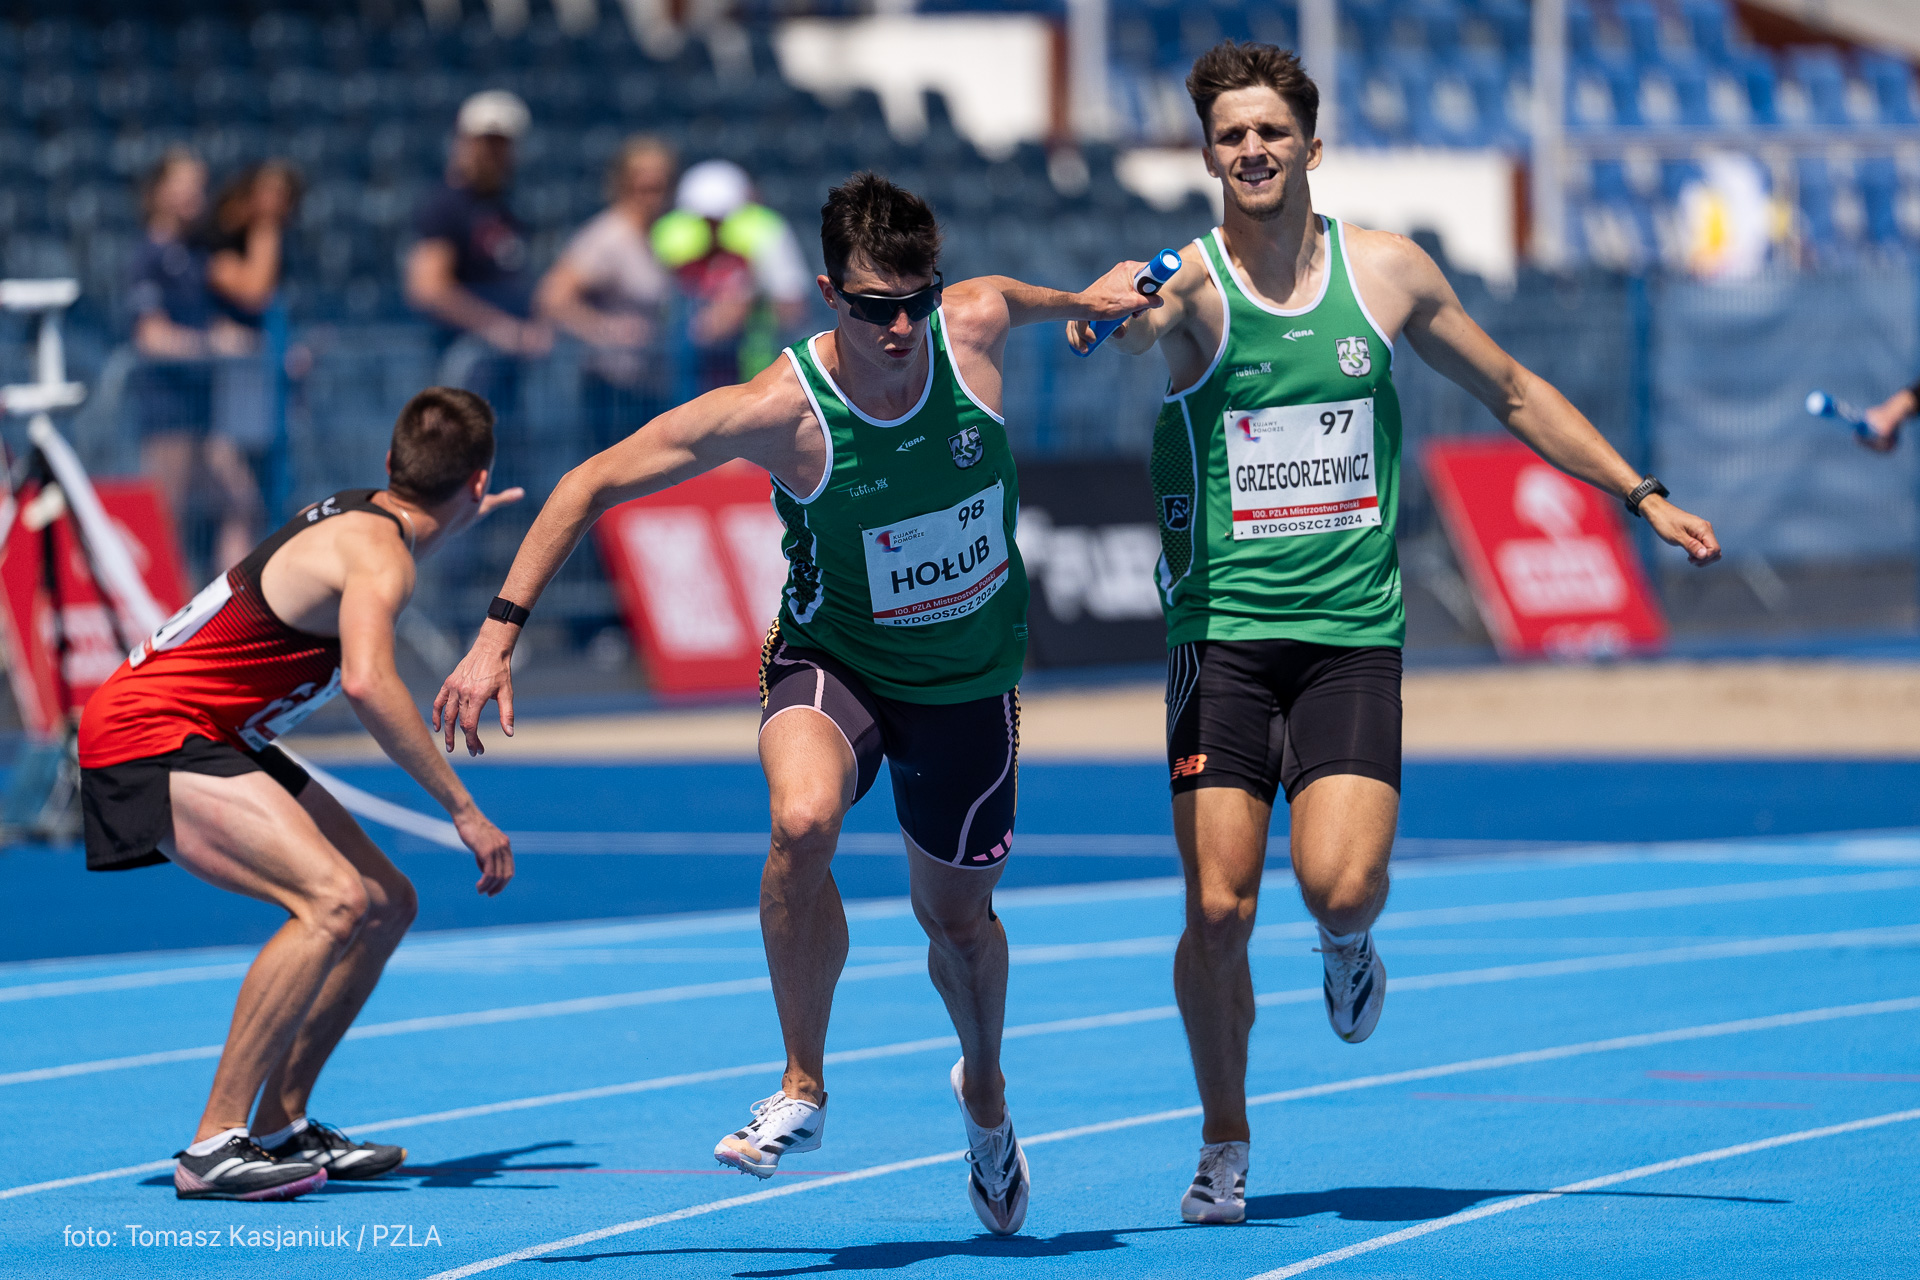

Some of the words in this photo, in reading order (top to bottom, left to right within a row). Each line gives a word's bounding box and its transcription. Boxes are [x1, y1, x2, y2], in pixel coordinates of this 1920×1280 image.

[1319, 409, 1354, 436] 97
[1236, 452, 1370, 492] GRZEGORZEWICZ
[958, 499, 985, 531] 98
[1252, 509, 1268, 519] 100.
[1269, 508, 1289, 518] PZLA
[1289, 504, 1339, 517] Mistrzostwa
[1339, 499, 1360, 510] Polski
[892, 528, 919, 540] KUJAWY
[893, 531, 925, 545] POMORZE
[1252, 518, 1331, 535] BYDGOSZCZ
[1334, 514, 1363, 527] 2024
[891, 535, 990, 594] HOŁUB
[893, 601, 975, 625] BYDGOSZCZ
[975, 583, 998, 605] 2024
[894, 606, 911, 616] 100.
[912, 602, 932, 613] PZLA
[933, 587, 980, 607] Mistrzostwa
[978, 572, 997, 589] Polski
